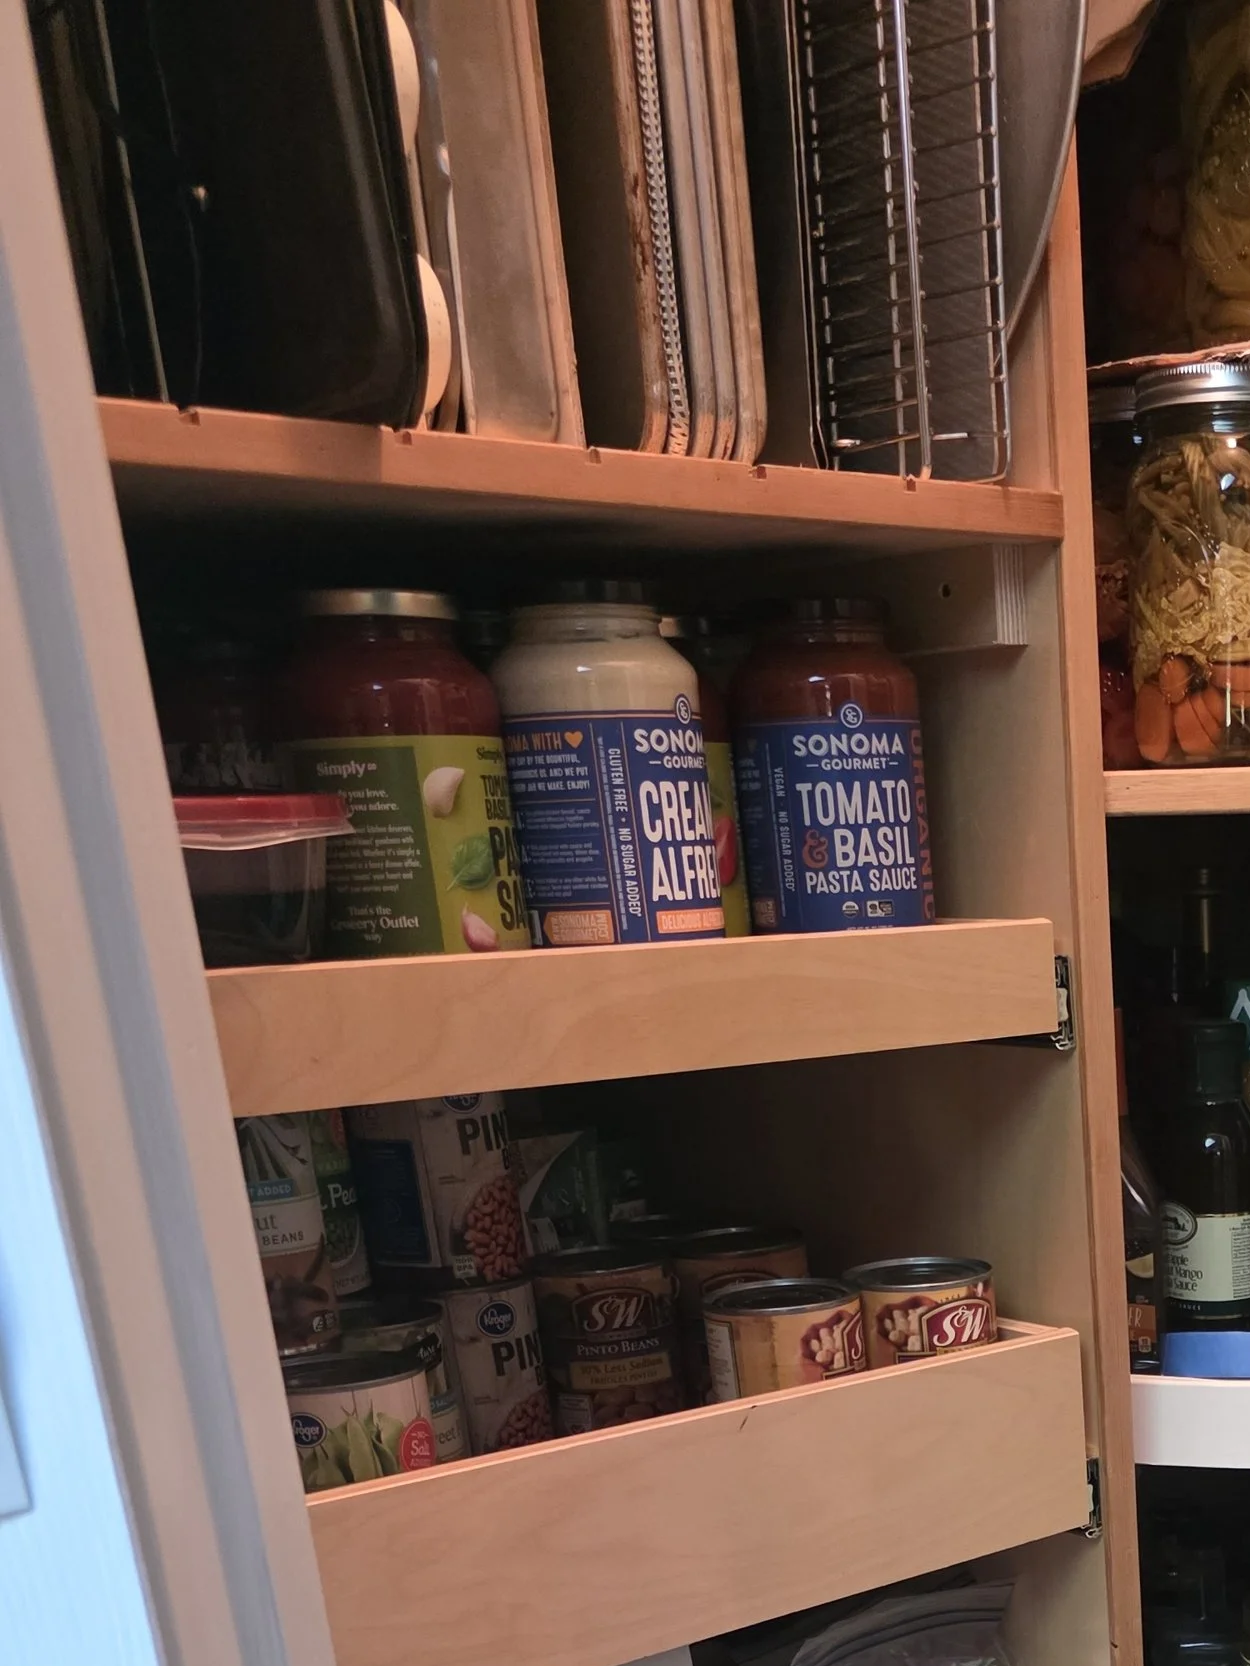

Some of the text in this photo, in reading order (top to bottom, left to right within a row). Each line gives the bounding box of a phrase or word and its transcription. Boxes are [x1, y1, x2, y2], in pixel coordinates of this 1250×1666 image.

[792, 732, 906, 757] SONOMA
[317, 762, 366, 780] Simply
[608, 748, 625, 786] GLUTEN
[822, 757, 889, 770] GOURMET
[614, 787, 628, 813] FREE
[795, 779, 911, 827] TOMATO
[618, 827, 630, 844] NO
[803, 826, 916, 869] & BASIL
[620, 844, 637, 877] SUGAR
[805, 867, 918, 895] PASTA SAUCE
[379, 916, 419, 930] Outlet
[262, 1230, 305, 1246] BEANS
[483, 1310, 513, 1329] Kroger
[583, 1293, 645, 1333] S&W
[932, 1305, 988, 1347] S&W
[577, 1336, 663, 1357] PINTO BEANS
